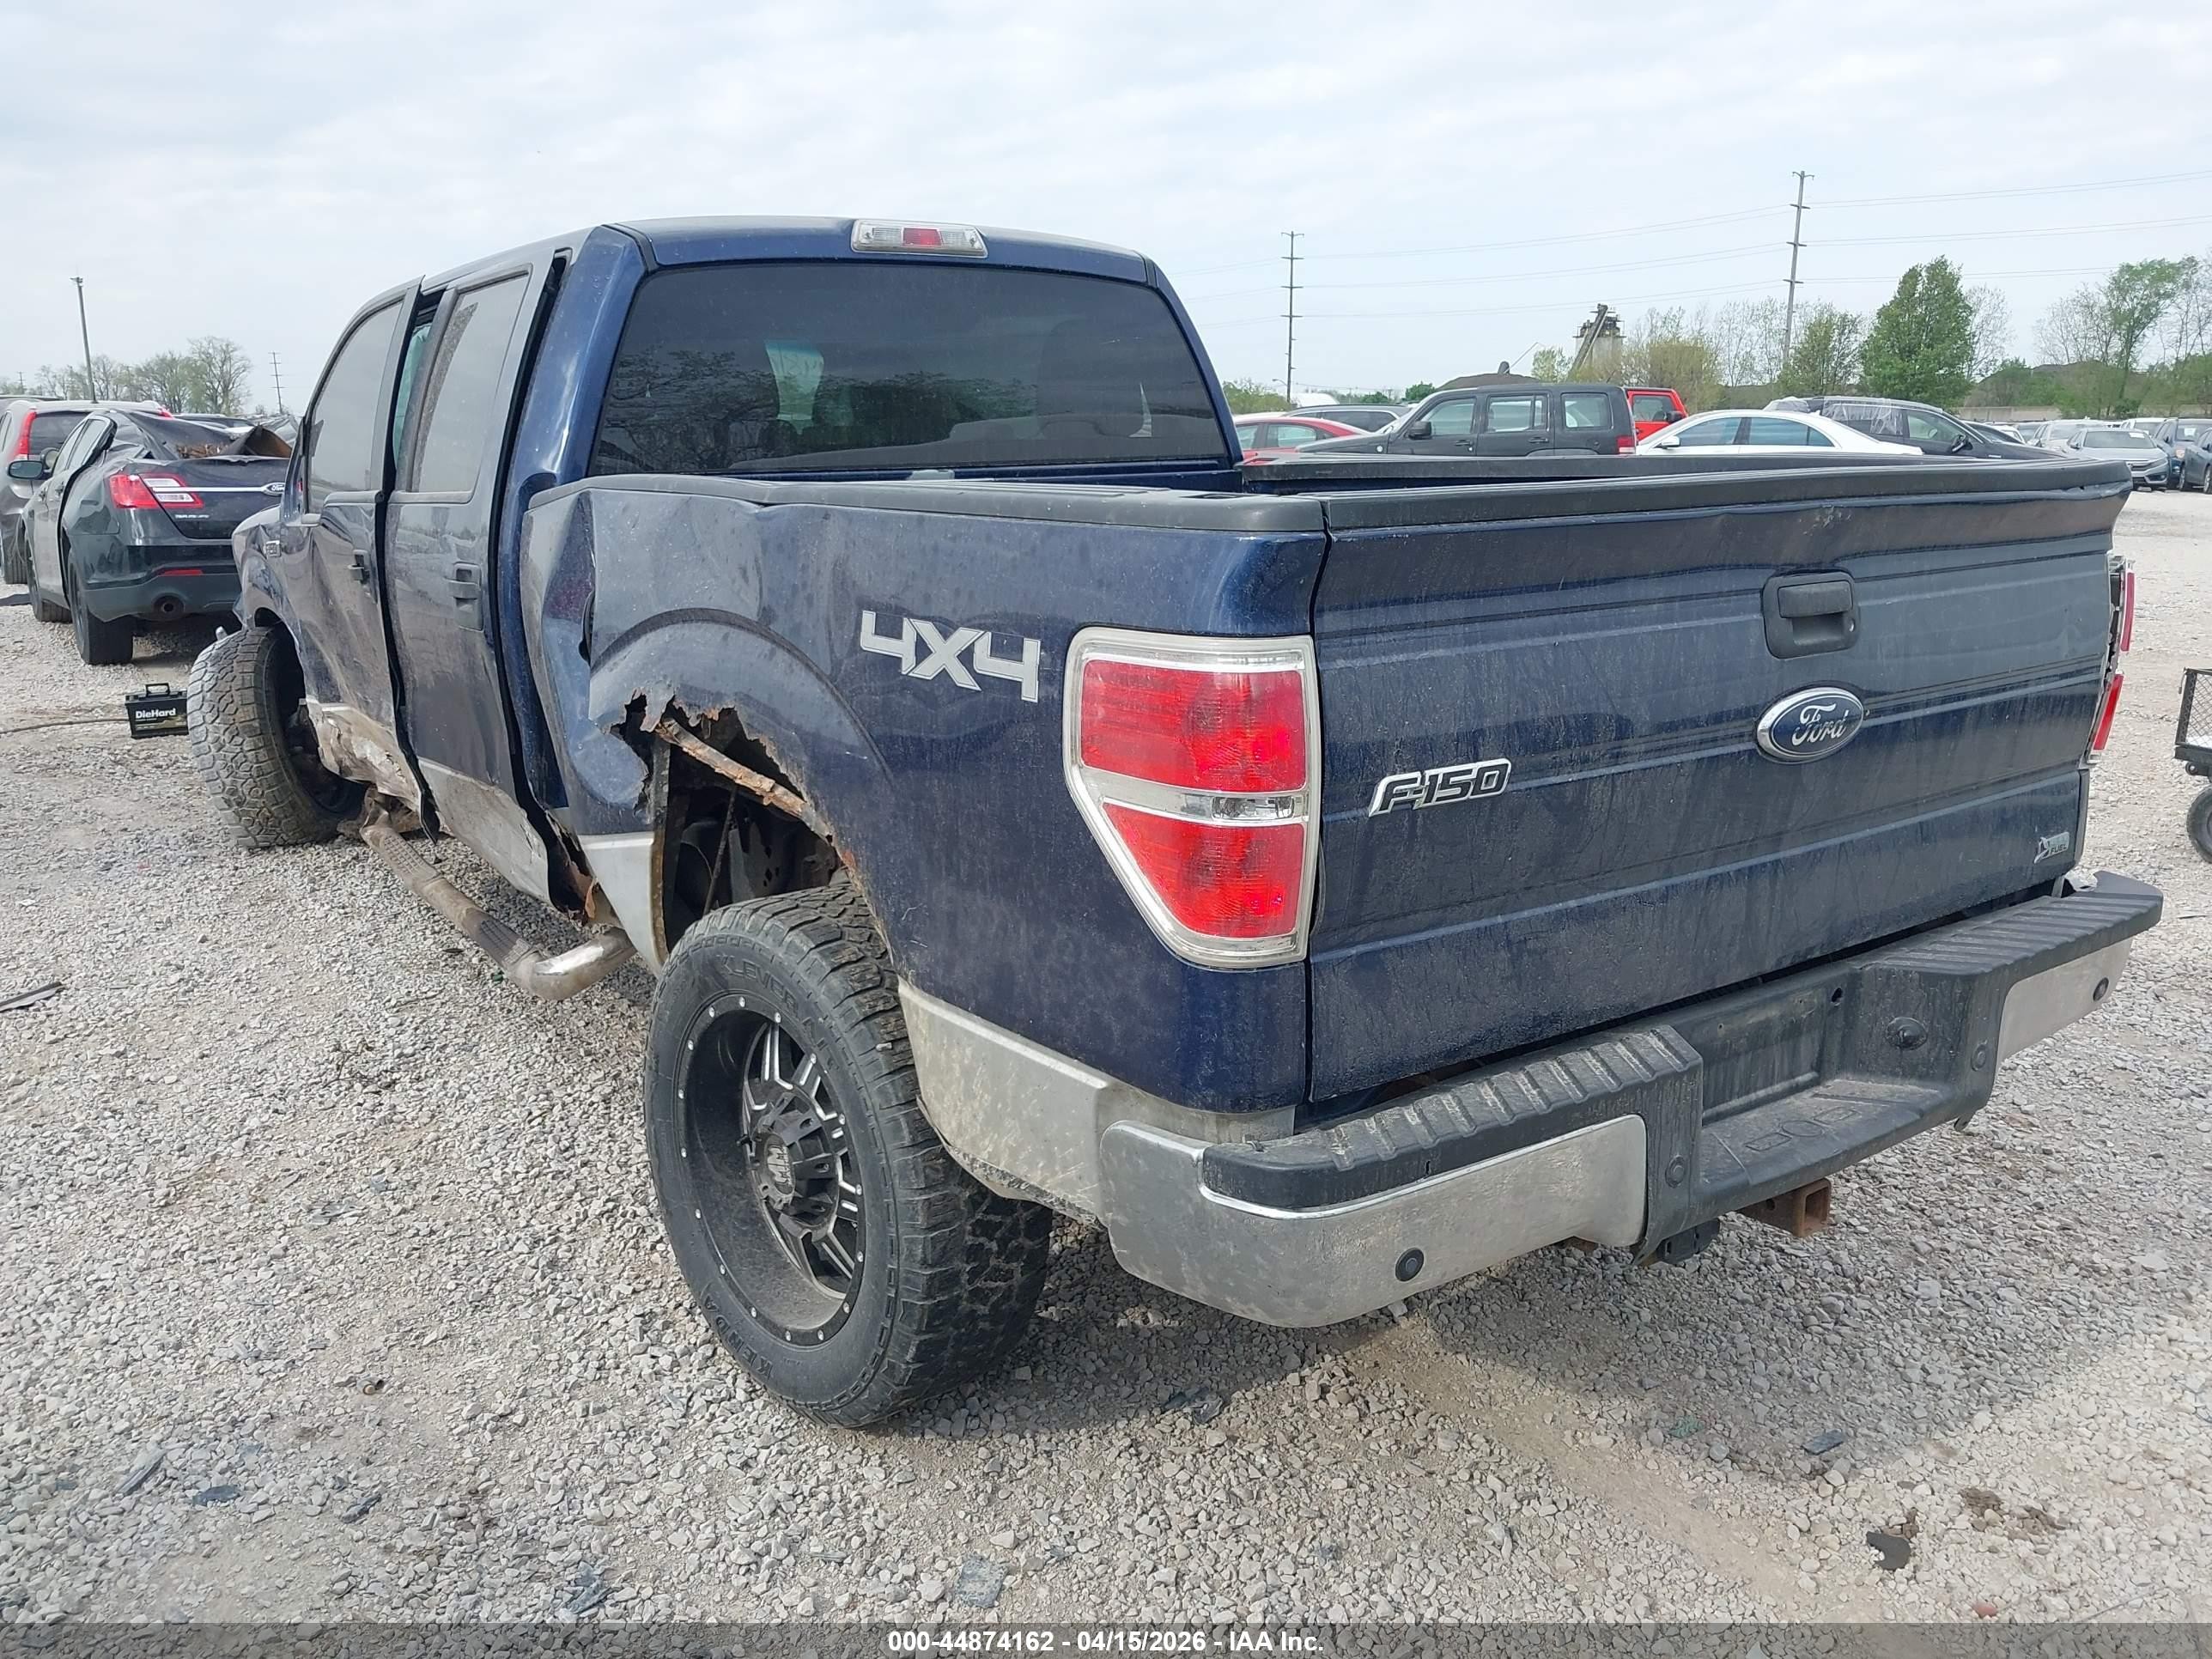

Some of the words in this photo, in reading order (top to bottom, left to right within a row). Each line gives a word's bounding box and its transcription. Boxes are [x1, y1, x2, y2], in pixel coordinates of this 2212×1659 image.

[135, 708, 176, 719] DieHard
[1791, 702, 1850, 746] Ford
[704, 1294, 775, 1381] KENDA
